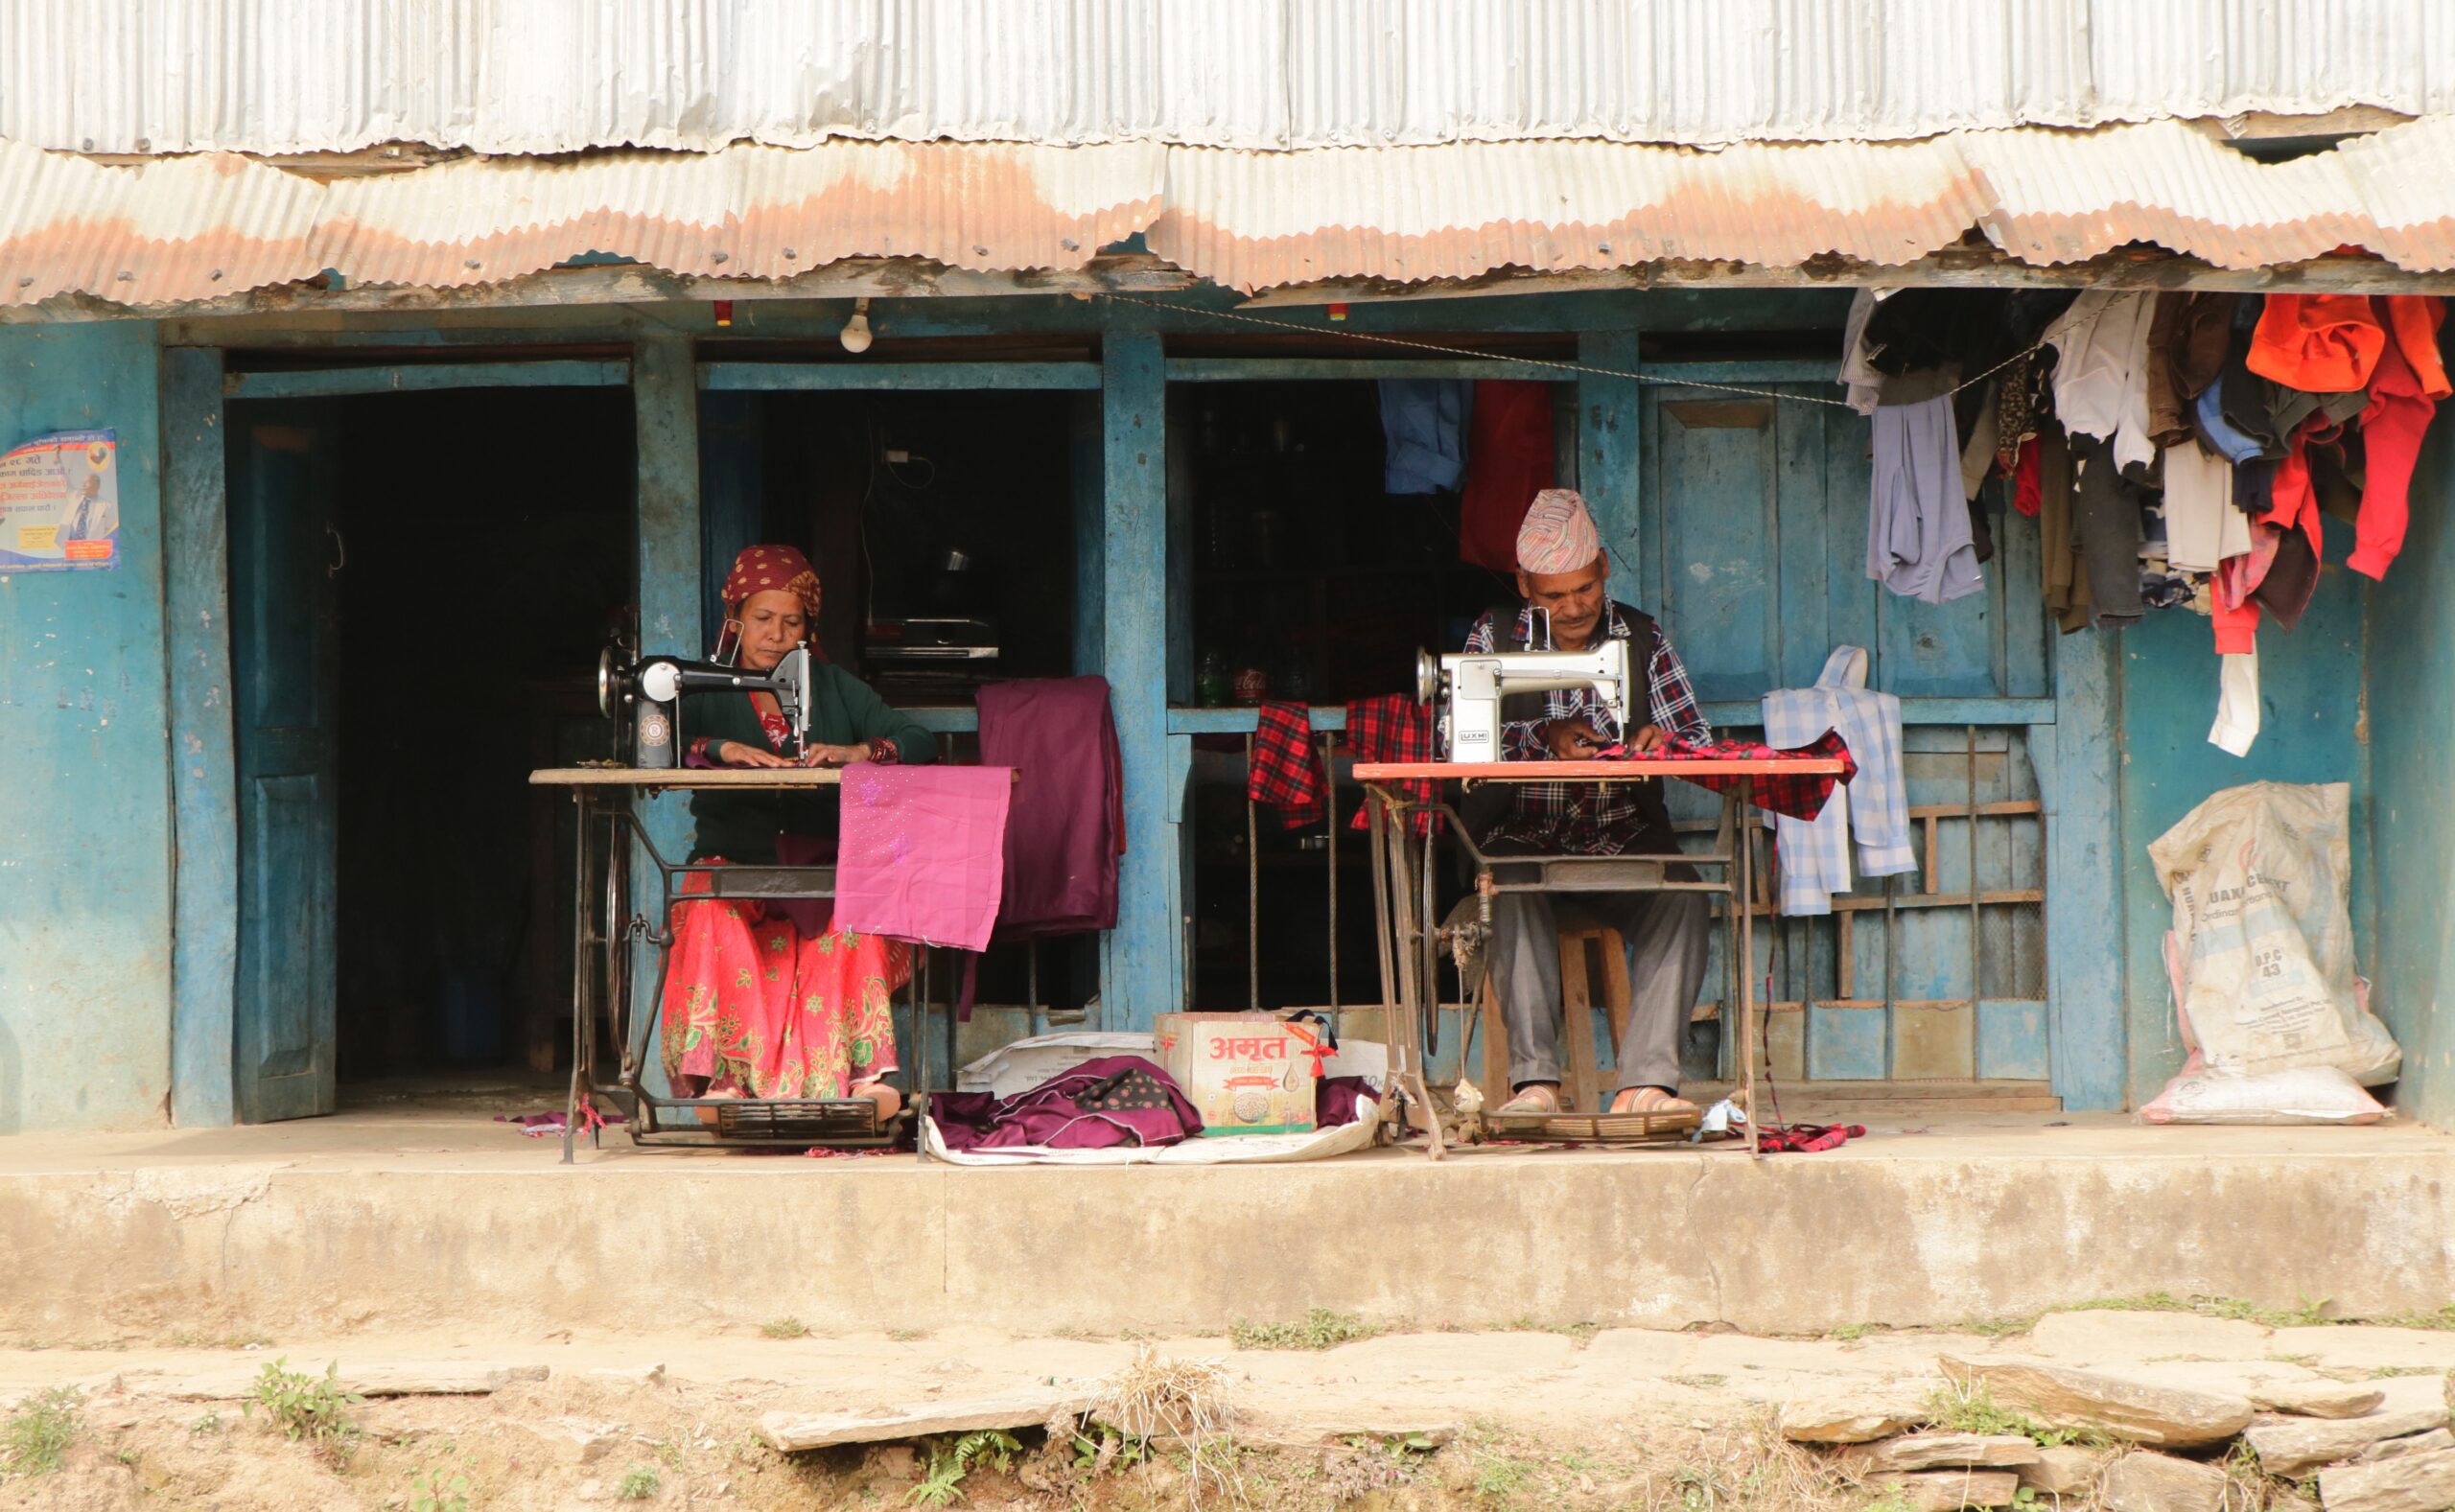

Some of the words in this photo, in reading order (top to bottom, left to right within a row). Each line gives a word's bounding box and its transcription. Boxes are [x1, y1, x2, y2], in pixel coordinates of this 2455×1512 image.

[1461, 733, 1487, 741] LUXMI
[2262, 964, 2281, 977] 43
[1209, 1036, 1288, 1061] अमृत
